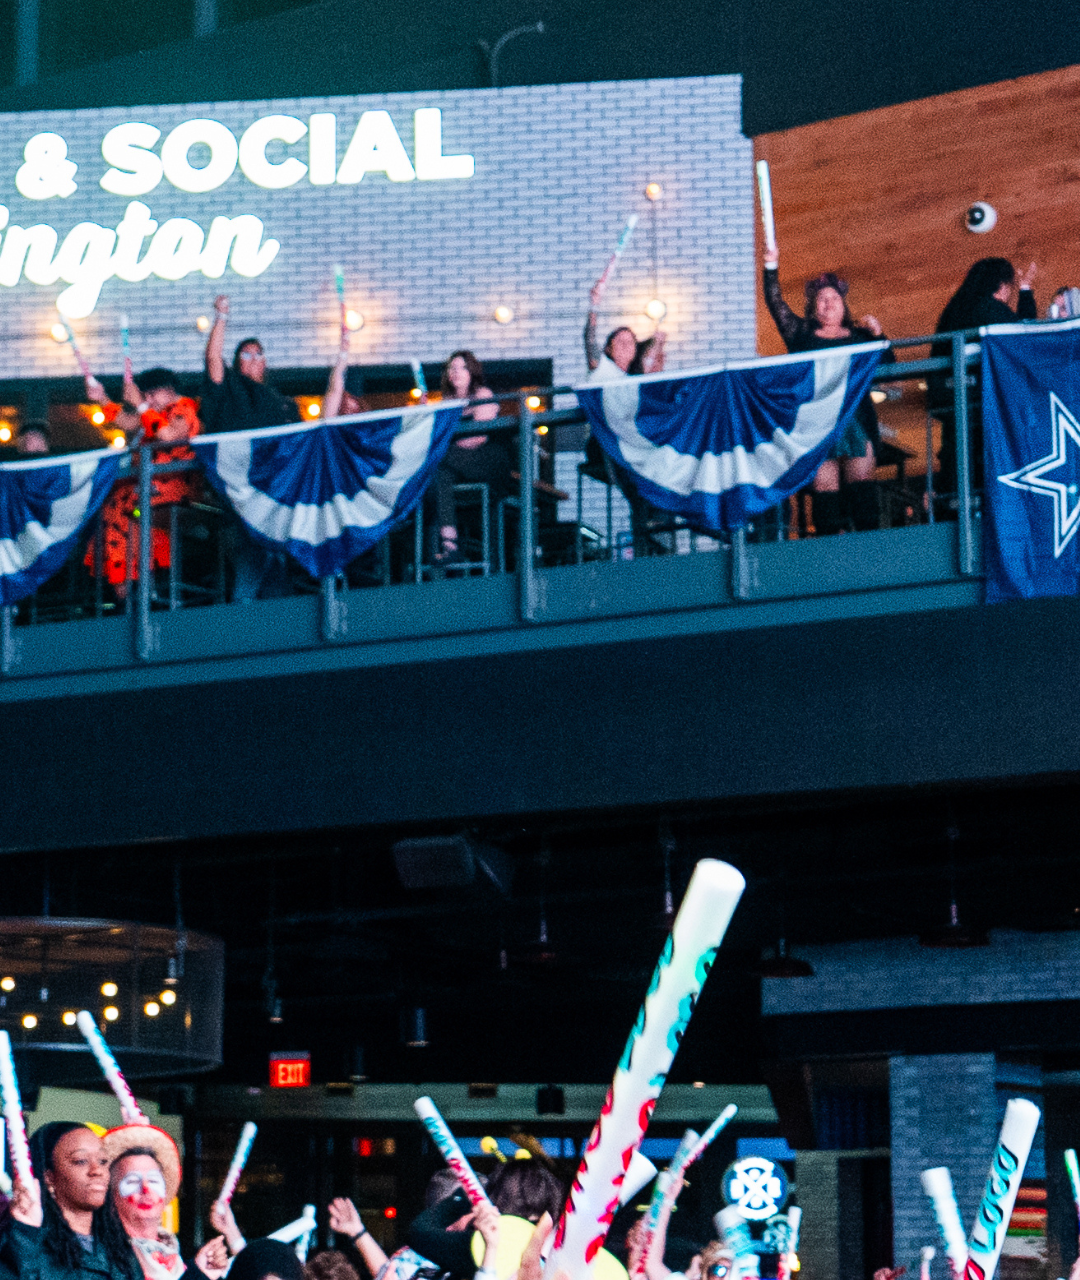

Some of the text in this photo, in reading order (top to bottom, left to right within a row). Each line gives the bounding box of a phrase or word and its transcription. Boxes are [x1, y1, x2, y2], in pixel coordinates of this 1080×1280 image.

[15, 130, 79, 200] &
[100, 106, 476, 197] SOCIAL
[277, 1063, 305, 1085] EXIT
[970, 1142, 1019, 1254] LOCO
